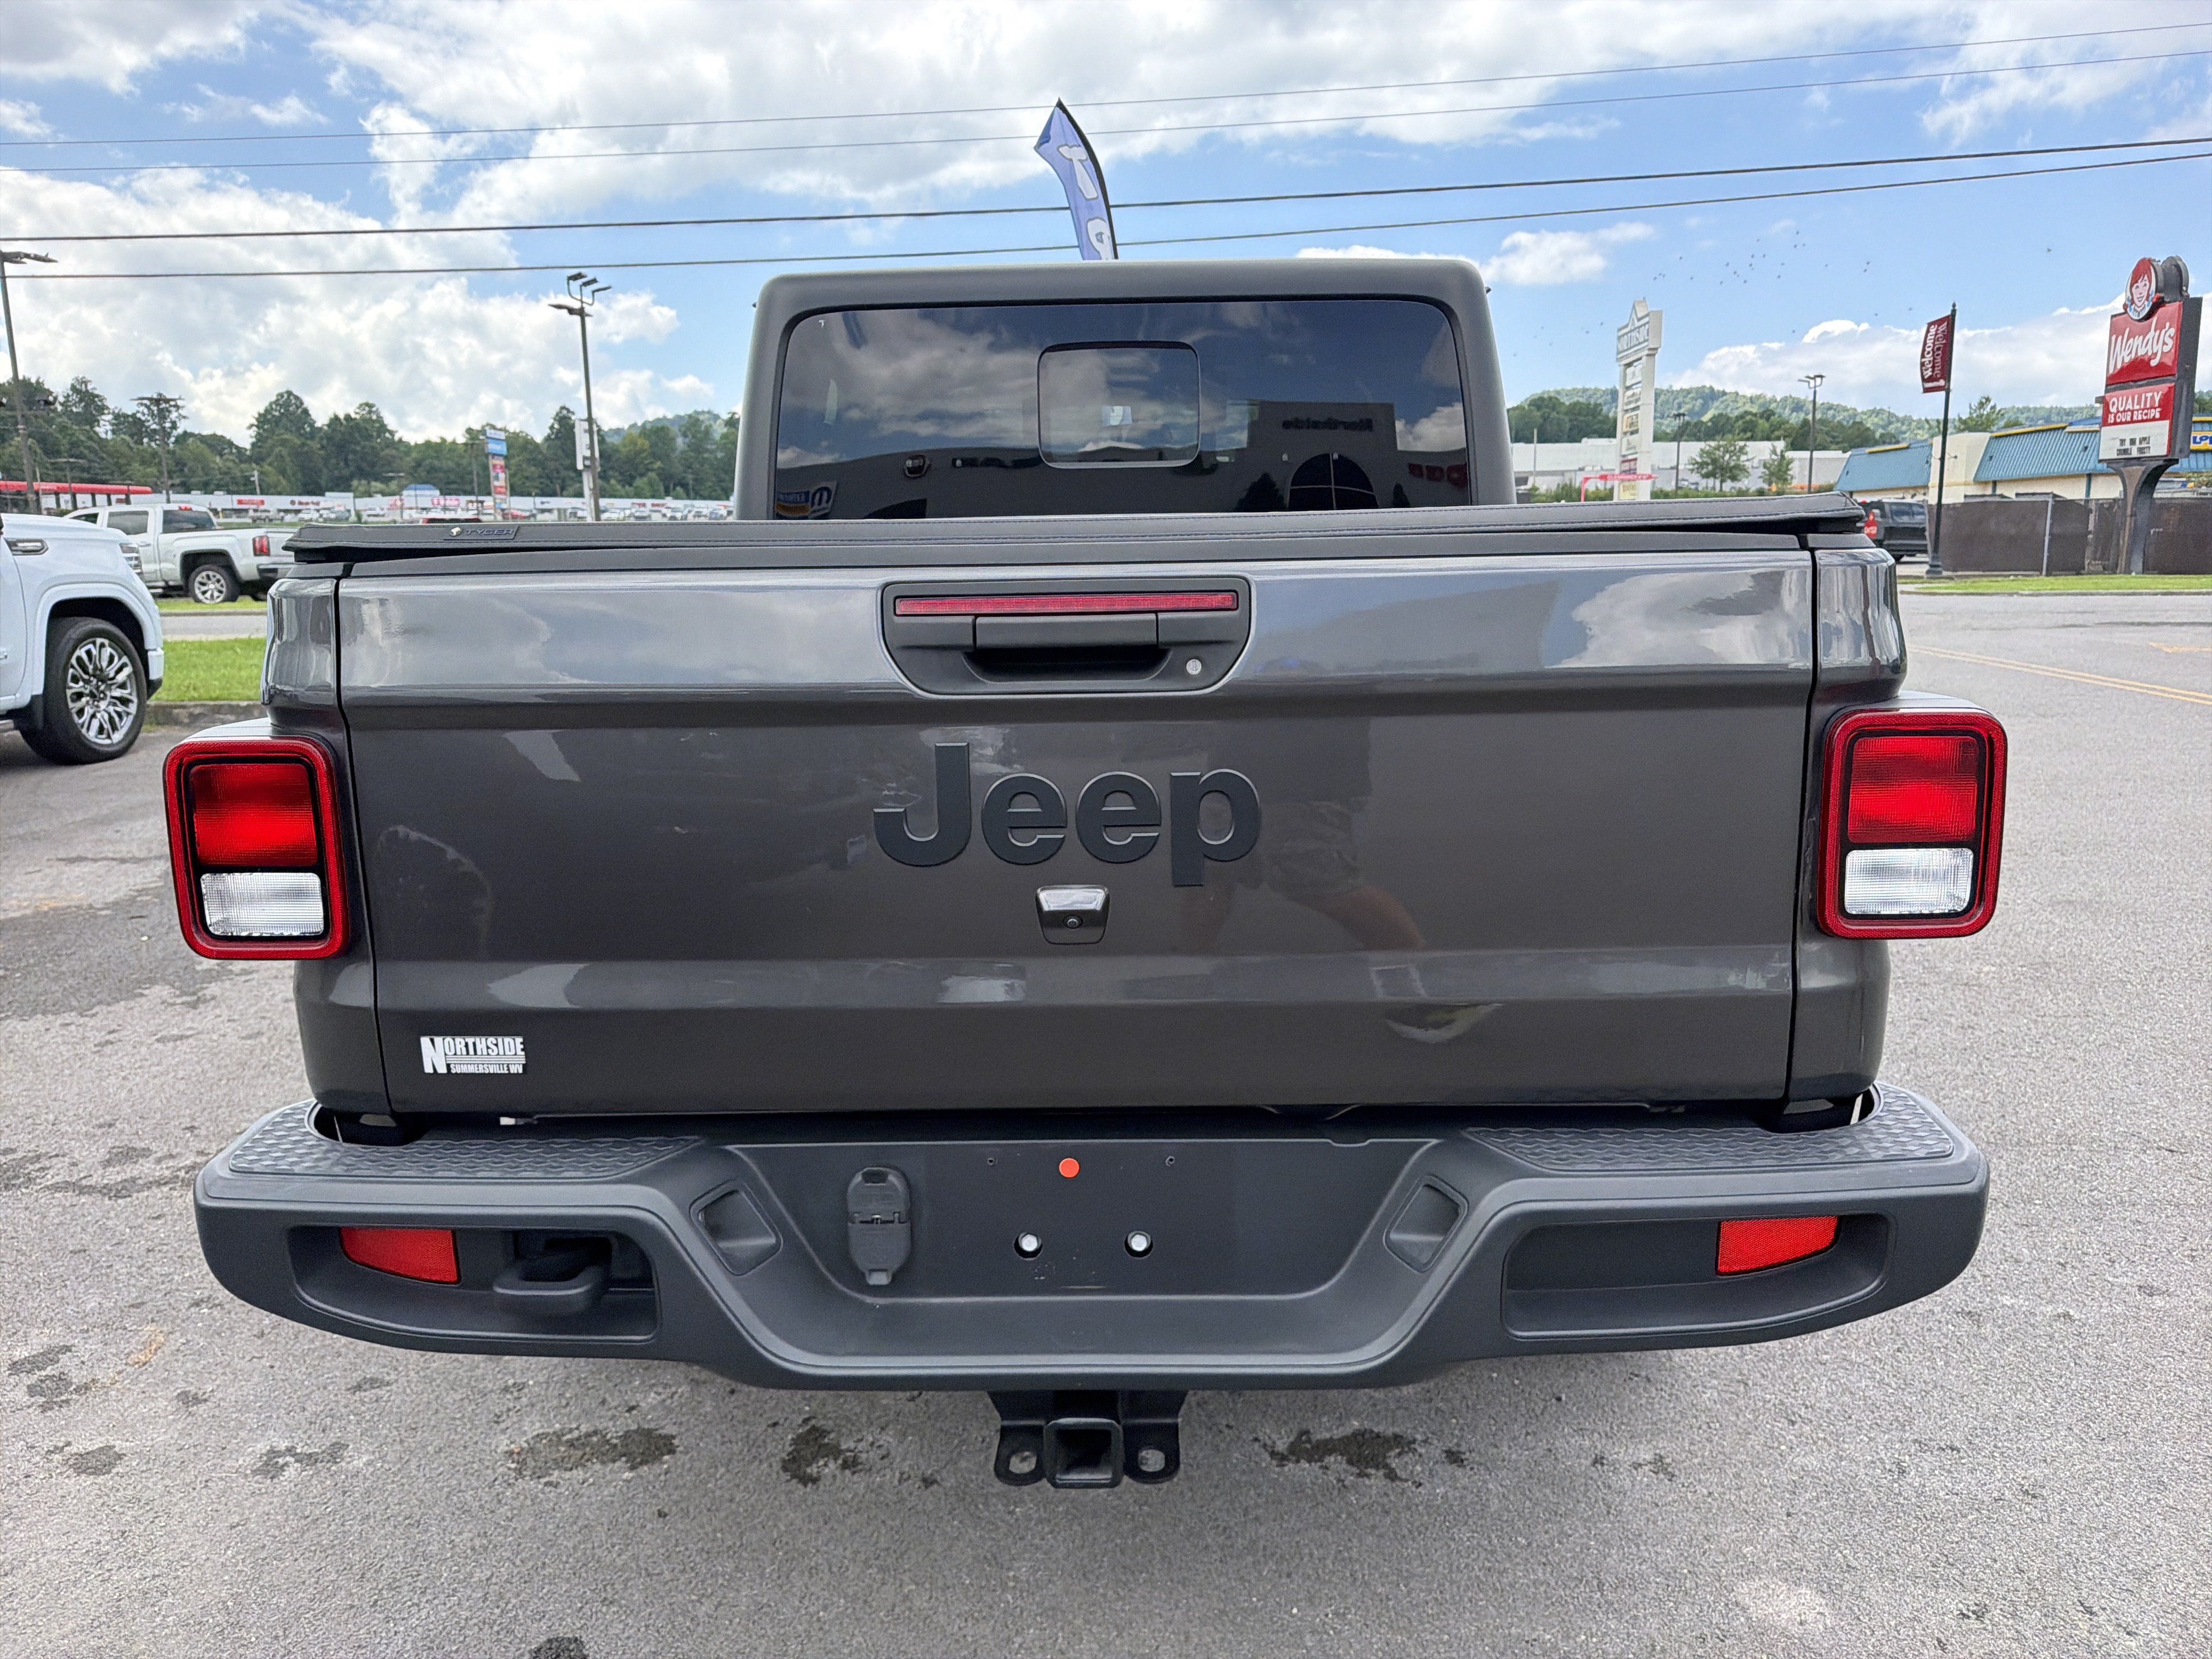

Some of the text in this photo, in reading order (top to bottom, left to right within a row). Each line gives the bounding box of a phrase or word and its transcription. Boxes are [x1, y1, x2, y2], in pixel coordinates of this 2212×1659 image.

[1921, 324, 1938, 379] Welcome
[2109, 316, 2175, 374] Wendy's
[2108, 408, 2162, 424] IS OUR RECIPE
[2109, 391, 2163, 413] QUALITY
[873, 742, 1261, 887] Jeep
[420, 1036, 526, 1073] NORTHSIDE
[450, 1063, 523, 1074] SUMMERSVILLE WV
